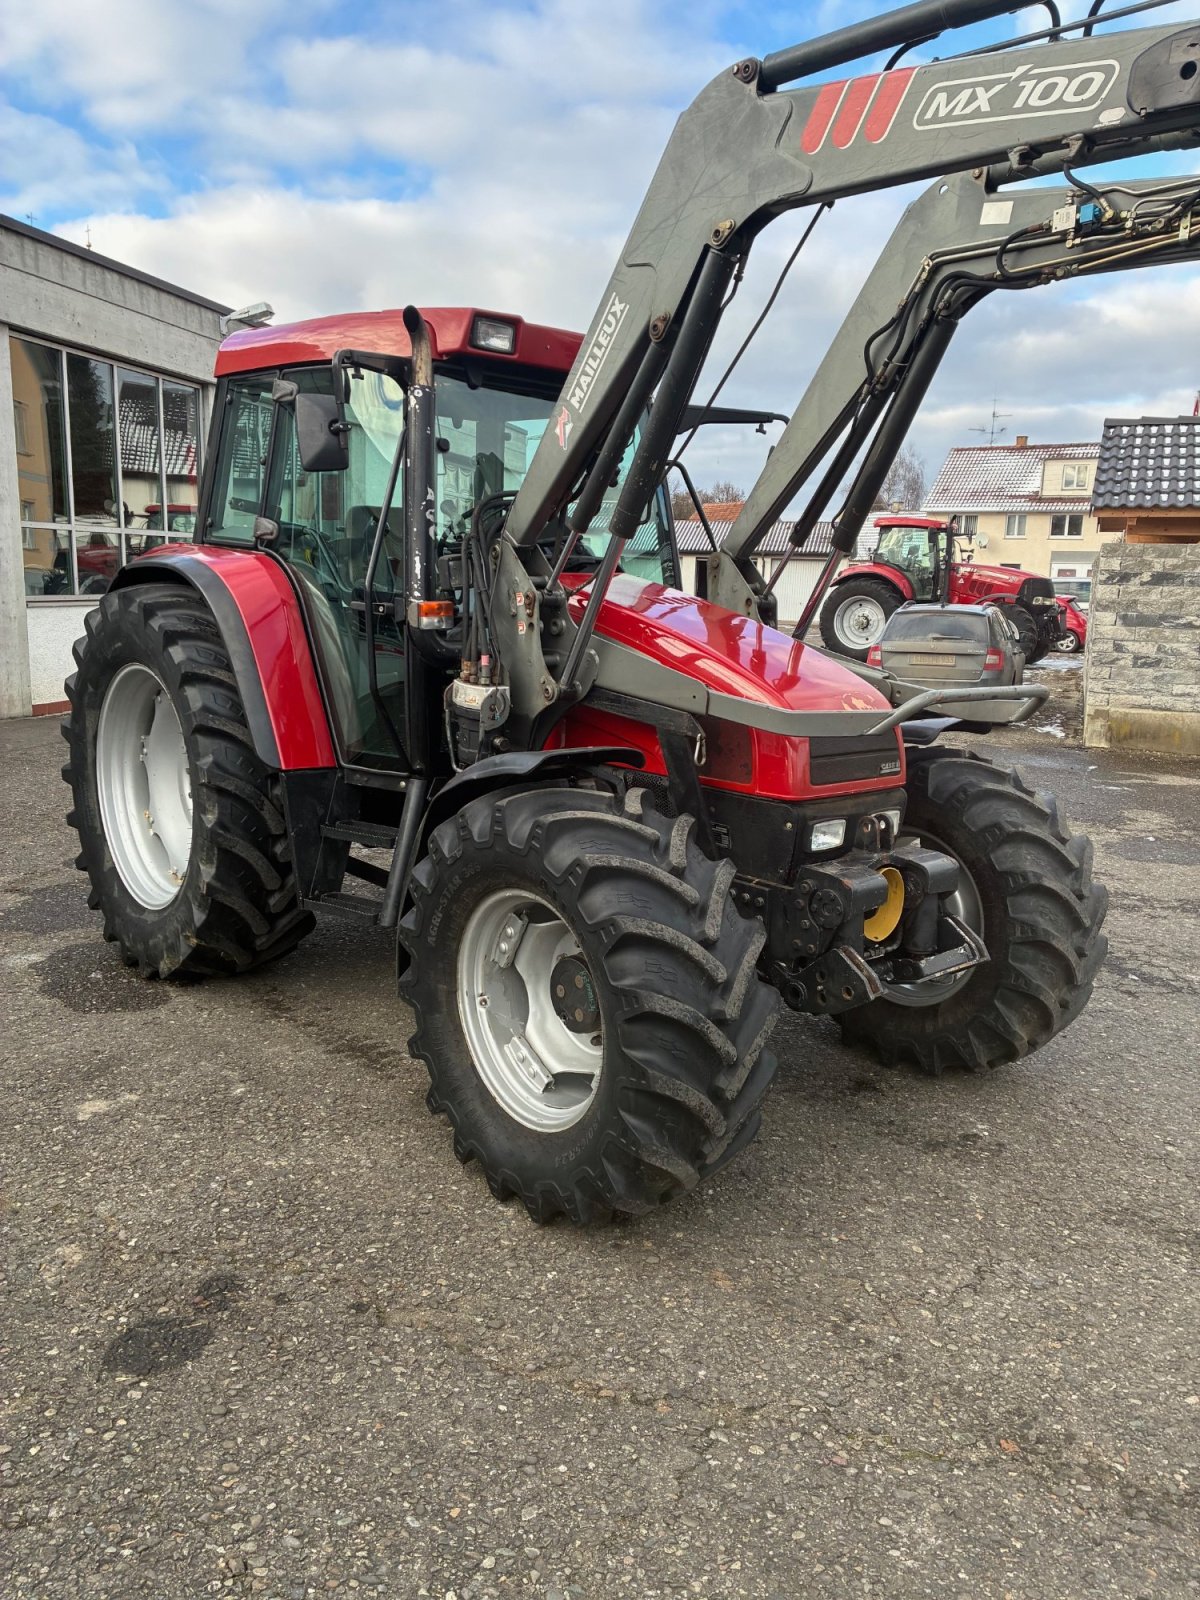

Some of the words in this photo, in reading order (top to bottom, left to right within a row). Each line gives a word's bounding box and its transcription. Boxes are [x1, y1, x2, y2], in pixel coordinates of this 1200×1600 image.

[923, 83, 1008, 120] MX
[1012, 71, 1106, 109] 100
[570, 296, 626, 410] MAILLEUX
